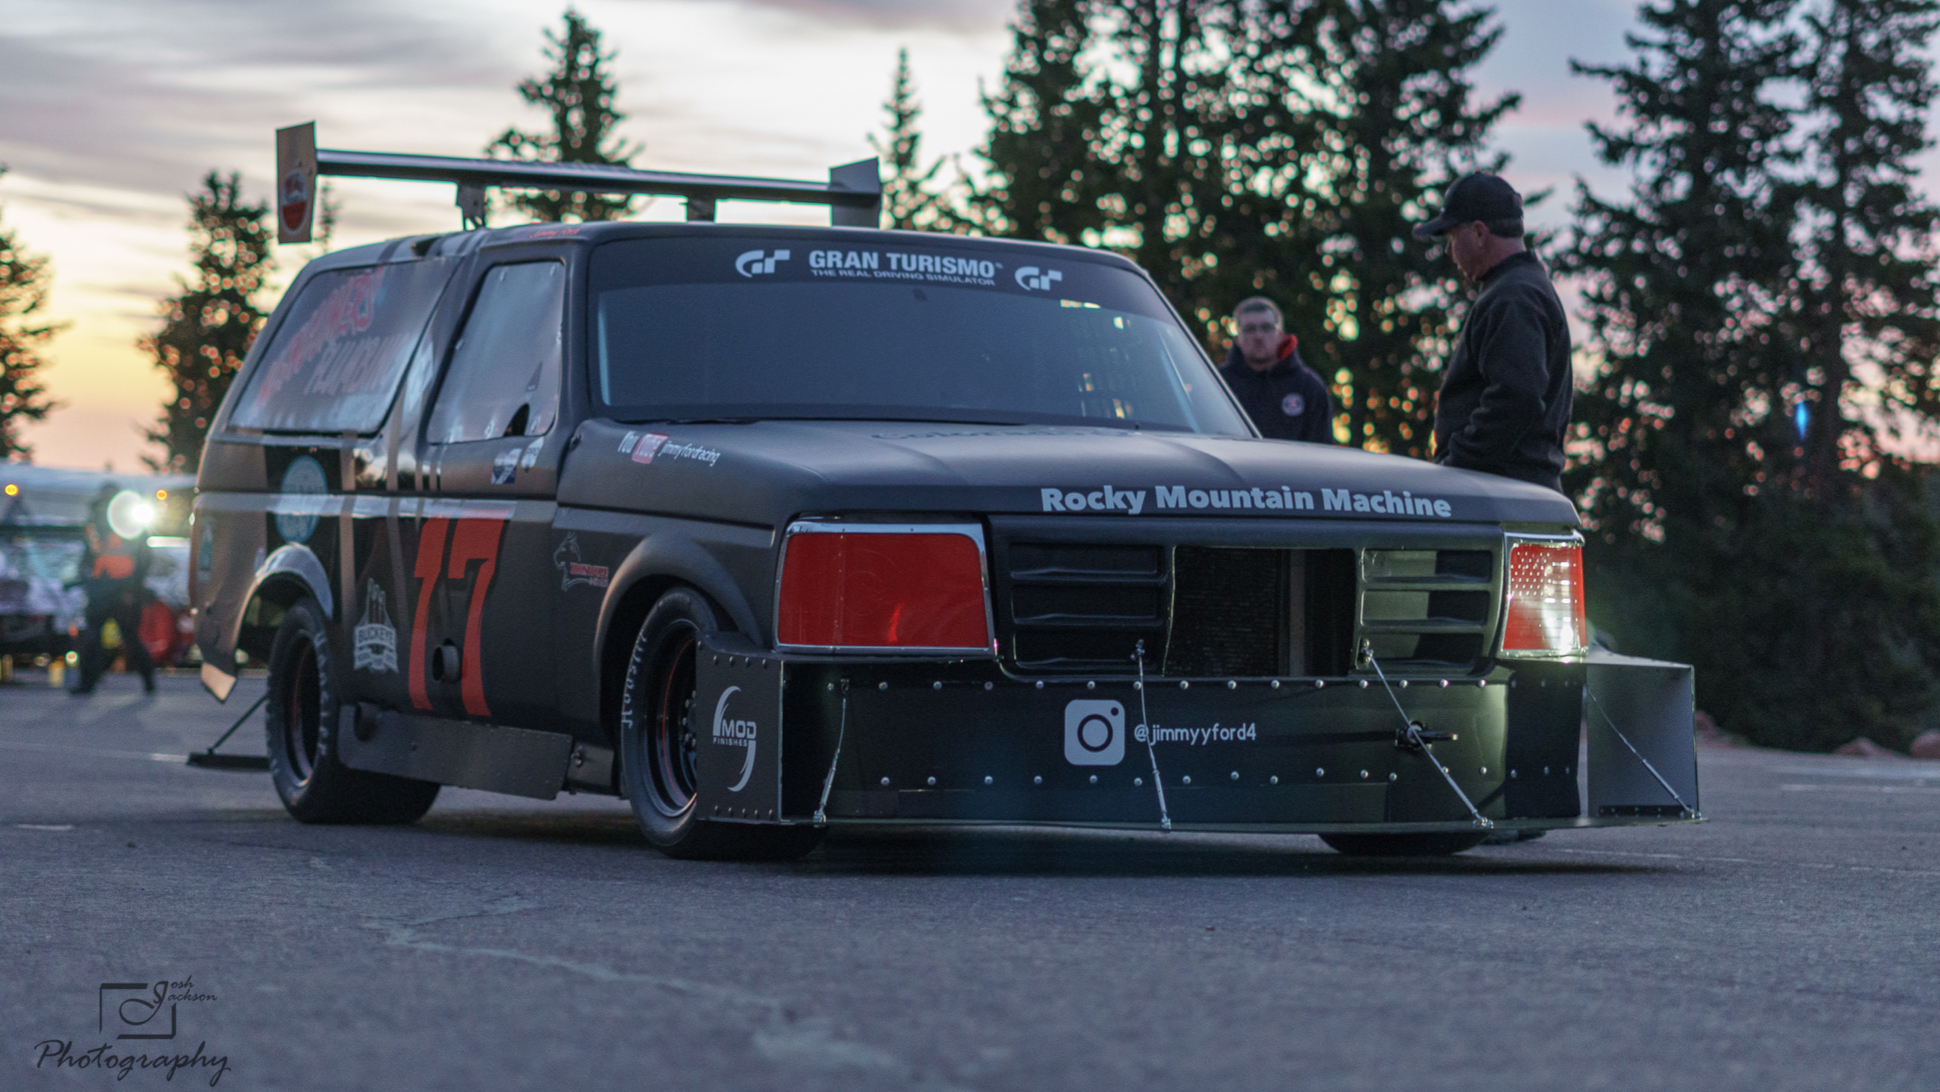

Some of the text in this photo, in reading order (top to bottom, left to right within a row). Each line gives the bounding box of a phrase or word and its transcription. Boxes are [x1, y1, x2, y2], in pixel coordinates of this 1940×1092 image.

[808, 250, 879, 269] GRAN
[811, 269, 996, 286] THE REAL DRIVING SIMULATOR
[1040, 485, 1452, 518] Rocky Mountain Machine
[721, 719, 757, 740] MOD
[1133, 722, 1257, 746] @jimmyyford4
[712, 736, 748, 747] FINISHES
